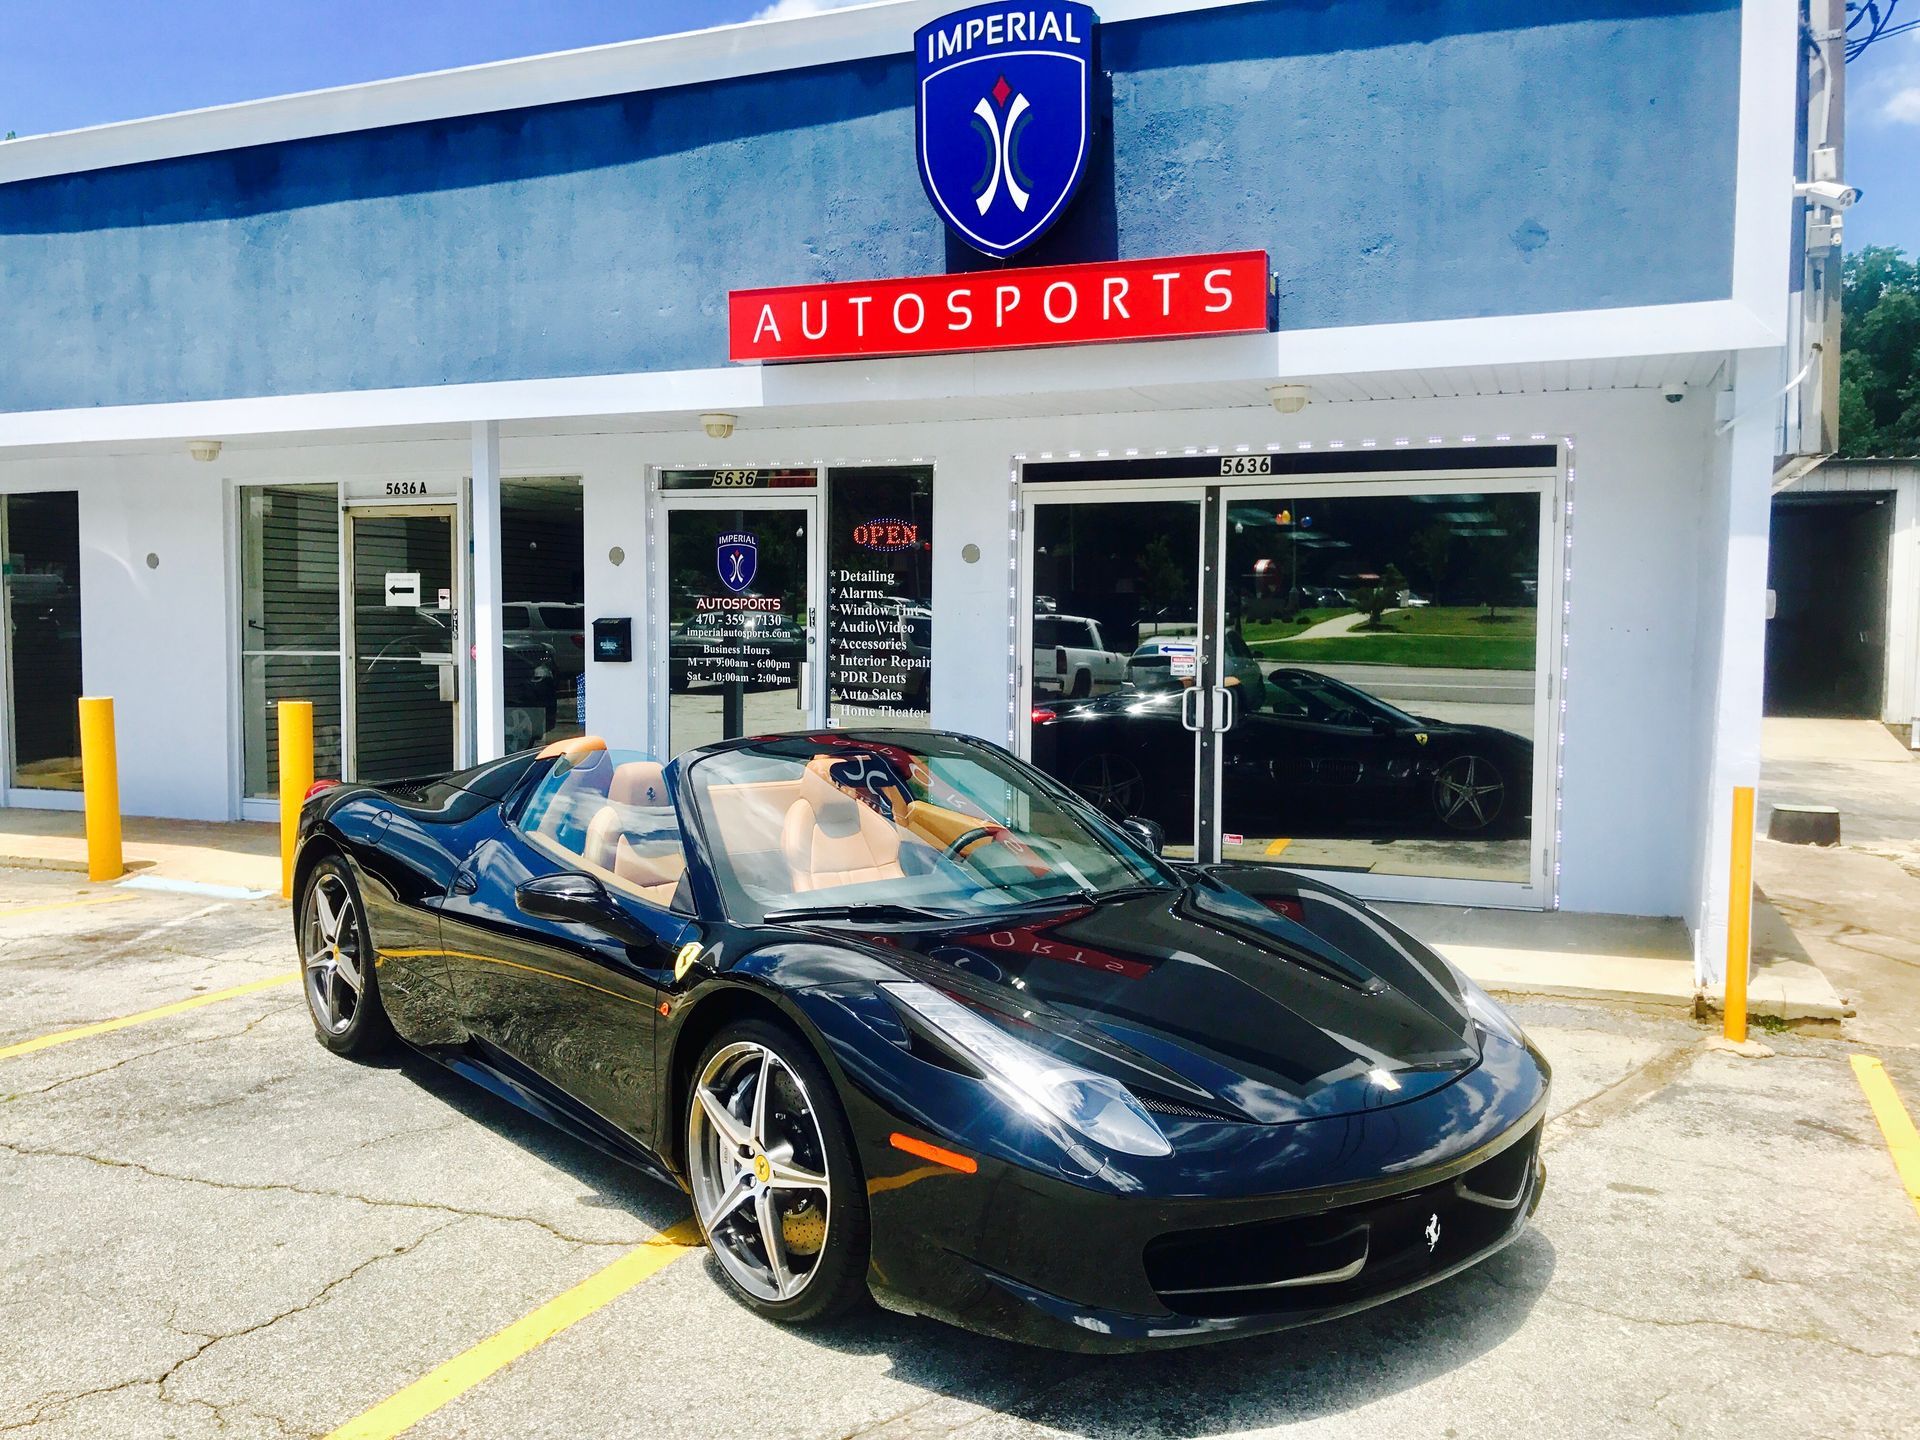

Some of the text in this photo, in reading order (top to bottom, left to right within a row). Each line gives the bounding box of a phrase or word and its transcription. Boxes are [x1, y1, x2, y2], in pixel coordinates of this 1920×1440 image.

[928, 11, 1081, 63] IMPERIAL
[753, 269, 1233, 343] AUTOSPORTS
[1222, 457, 1270, 474] 5636
[713, 471, 756, 486] 5636
[385, 481, 427, 495] 5636 A
[718, 534, 757, 545] IMPERIAL
[853, 524, 919, 545] OPEN
[840, 570, 896, 586] Detailing
[839, 587, 884, 599] Alarms
[696, 597, 781, 610] AUTOSPORTS
[840, 603, 920, 616] Window Tint
[695, 613, 716, 625] 470
[725, 613, 745, 626] 359
[755, 614, 782, 626] 7130
[687, 627, 791, 640] imperialautosports.com
[839, 619, 915, 636] Audio\Video
[703, 644, 771, 655] Business Hours
[839, 637, 907, 651] Accessories
[716, 658, 749, 668] 9:00am
[756, 659, 791, 671] 6:00pm
[840, 654, 931, 671] Interior Repair
[686, 671, 702, 681] Sat
[712, 672, 749, 682] 10:00am
[757, 673, 791, 685] 2:00pm
[840, 671, 907, 684] PDR Dents
[839, 688, 903, 701] Auto Sales
[840, 704, 927, 719] Home Theater
